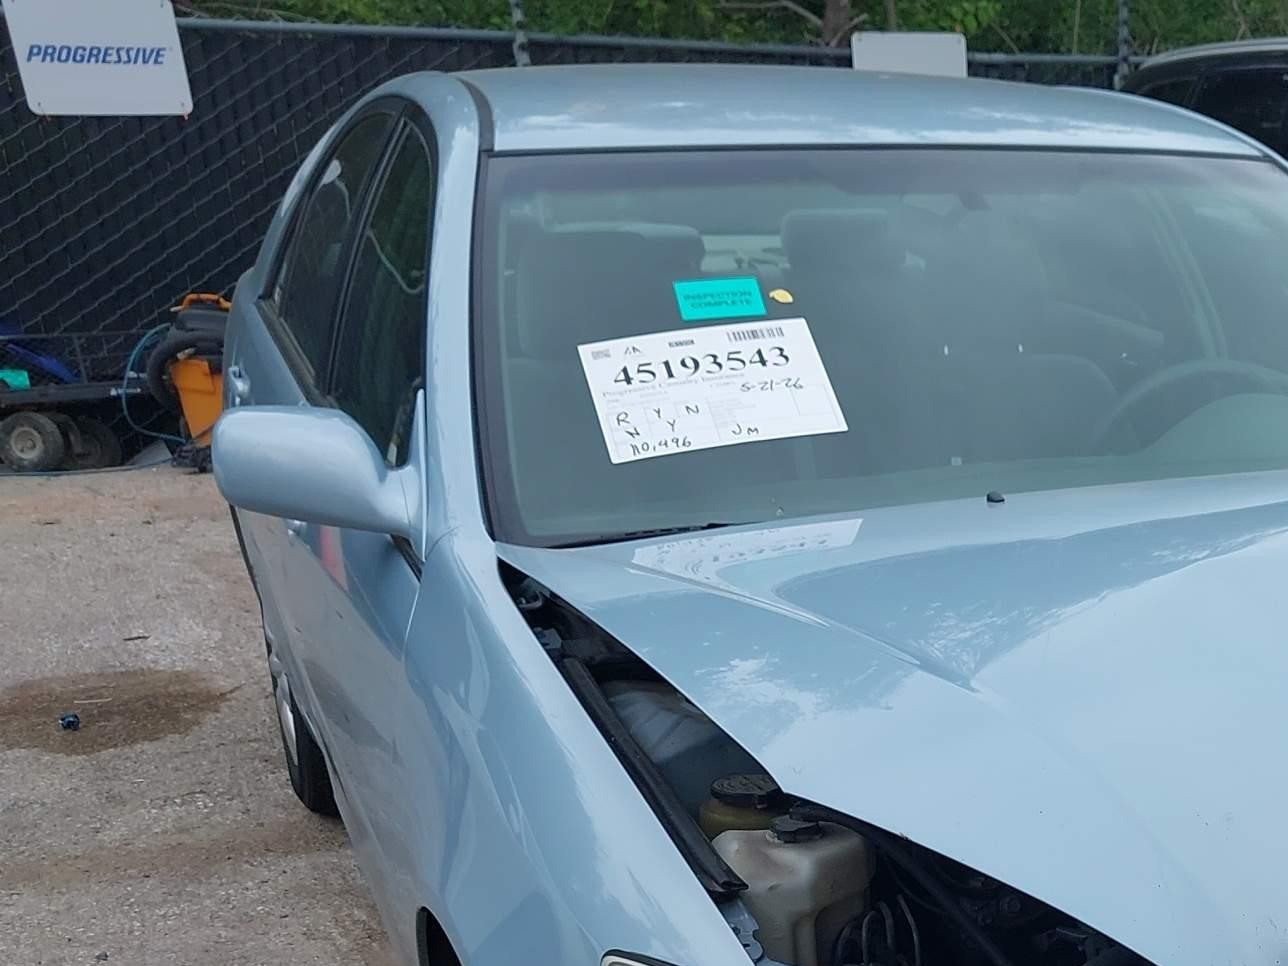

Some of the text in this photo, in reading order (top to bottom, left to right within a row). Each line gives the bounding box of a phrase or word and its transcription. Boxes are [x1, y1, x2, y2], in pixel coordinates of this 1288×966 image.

[27, 44, 167, 65] PROGRESSIVE
[613, 346, 790, 386] 45193543
[616, 411, 630, 426] R
[685, 404, 700, 415] N
